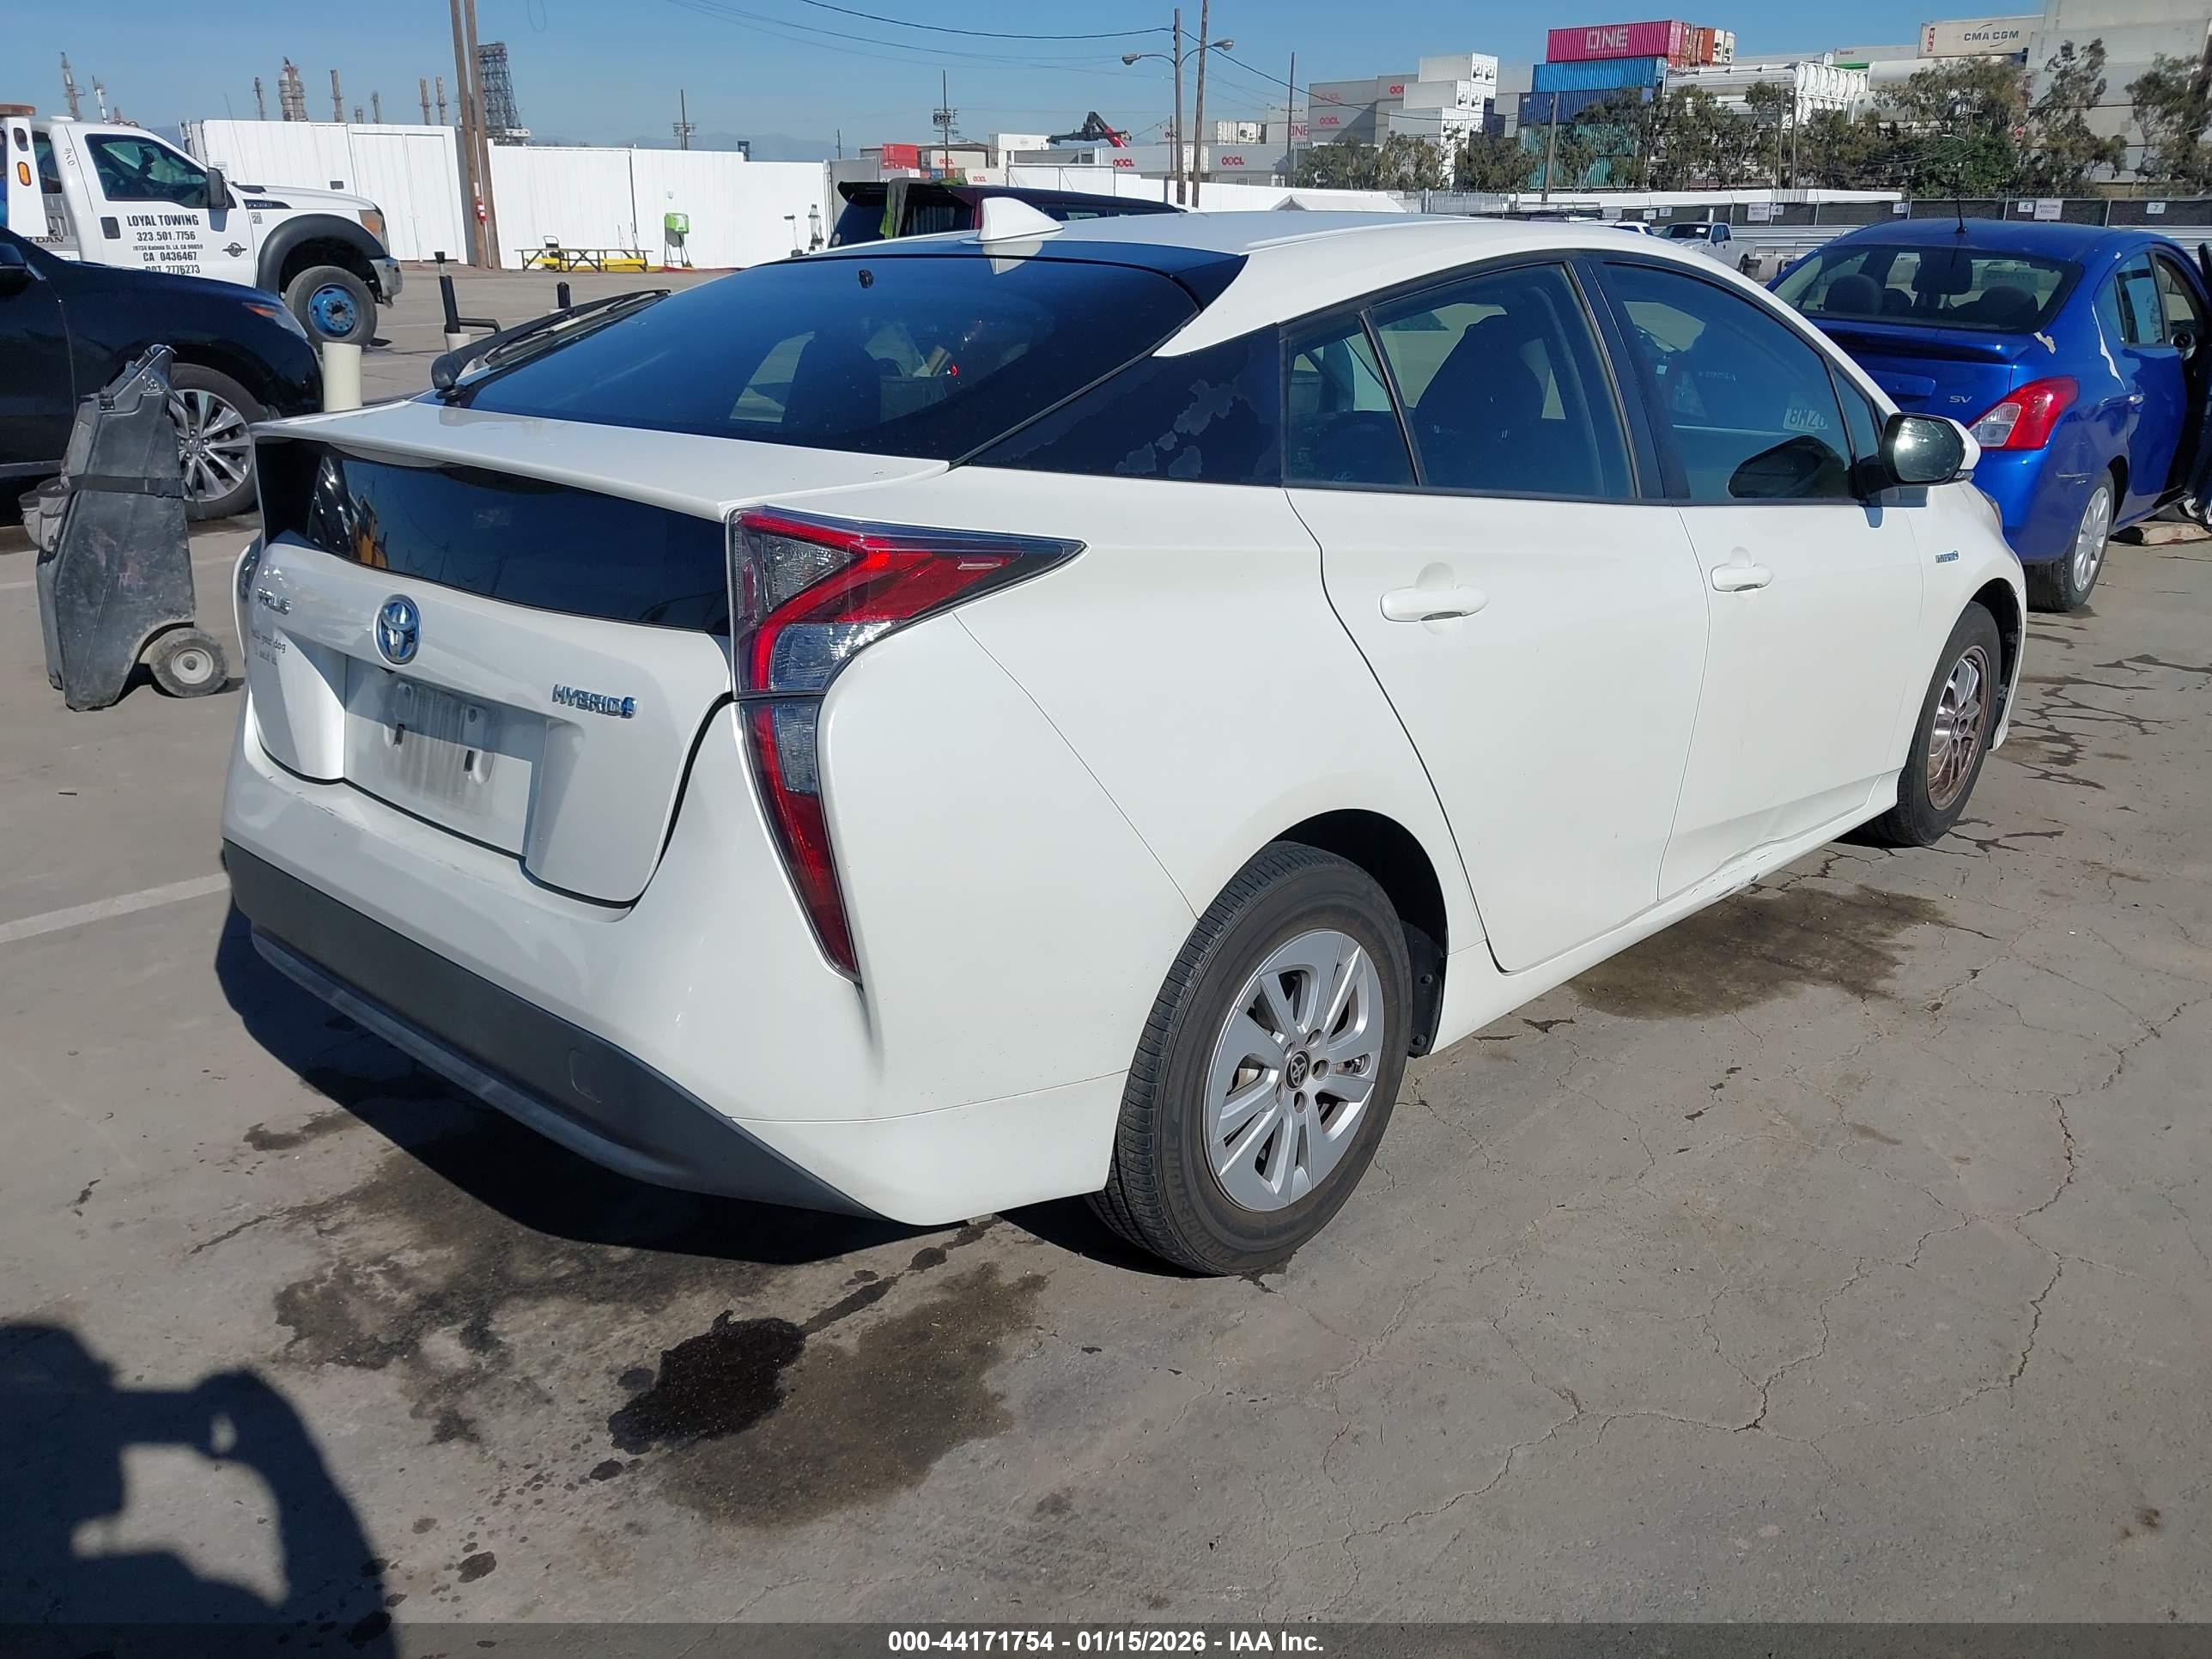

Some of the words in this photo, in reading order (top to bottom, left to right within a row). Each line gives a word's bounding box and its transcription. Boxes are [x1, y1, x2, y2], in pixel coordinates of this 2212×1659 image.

[1585, 25, 1628, 48] ONE
[1964, 32, 1990, 41] CMA
[1993, 30, 2020, 40] CGM
[1389, 85, 1404, 94] OO
[1319, 116, 1340, 125] OOCL
[1113, 158, 1134, 167] OOCL
[1221, 156, 1244, 166] OOCL
[126, 215, 157, 227] LOYAL
[157, 215, 199, 227] TOWING
[136, 230, 196, 242] 323.501.7756
[143, 252, 155, 262] CA
[160, 252, 197, 262] 0436467
[1949, 395, 1972, 404] SV
[273, 639, 286, 653] dog
[552, 684, 620, 716] HYBRID
